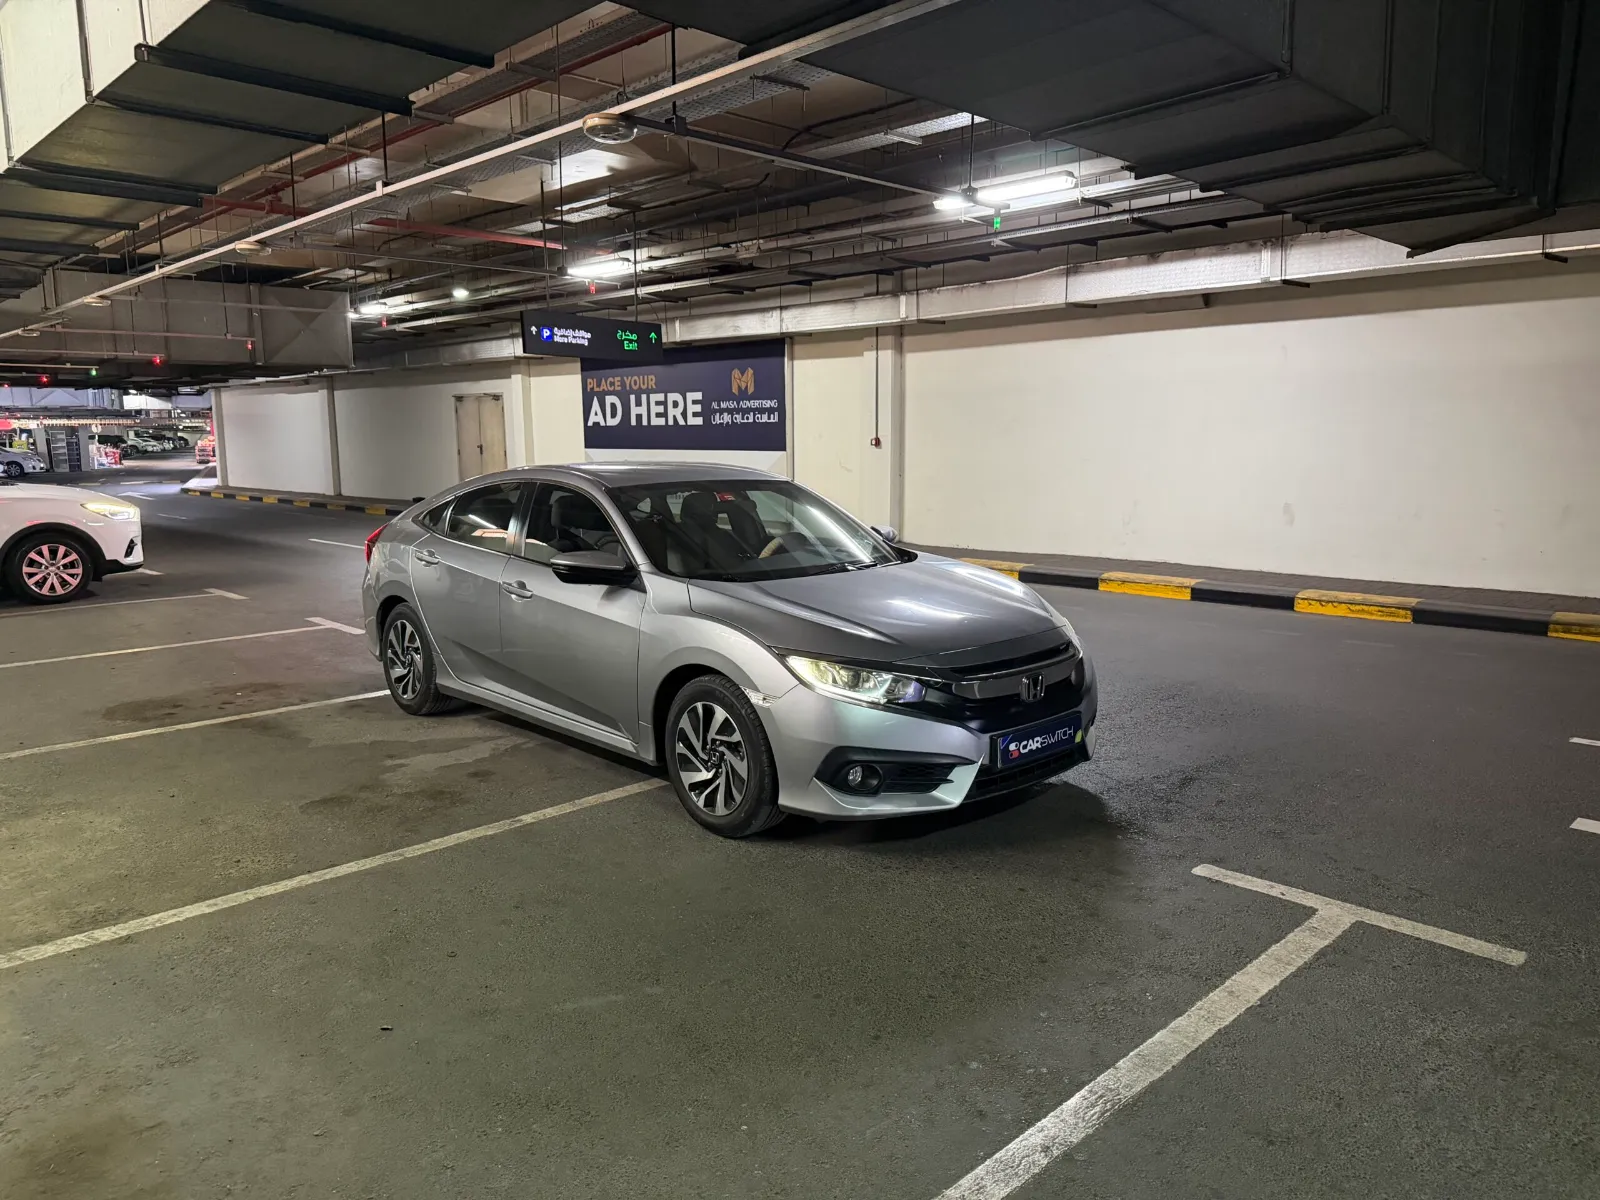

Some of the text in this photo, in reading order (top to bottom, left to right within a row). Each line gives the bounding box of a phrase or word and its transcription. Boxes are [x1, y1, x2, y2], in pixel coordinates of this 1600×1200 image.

[553, 335, 589, 346] More Parking
[616, 330, 638, 340] مخرج
[624, 341, 638, 350] Exit
[587, 375, 657, 392] PLACE YOUR
[587, 391, 704, 427] AD HERE
[711, 399, 778, 409] AL MASA ADVERTISING
[1020, 726, 1074, 754] CARSWITCH
